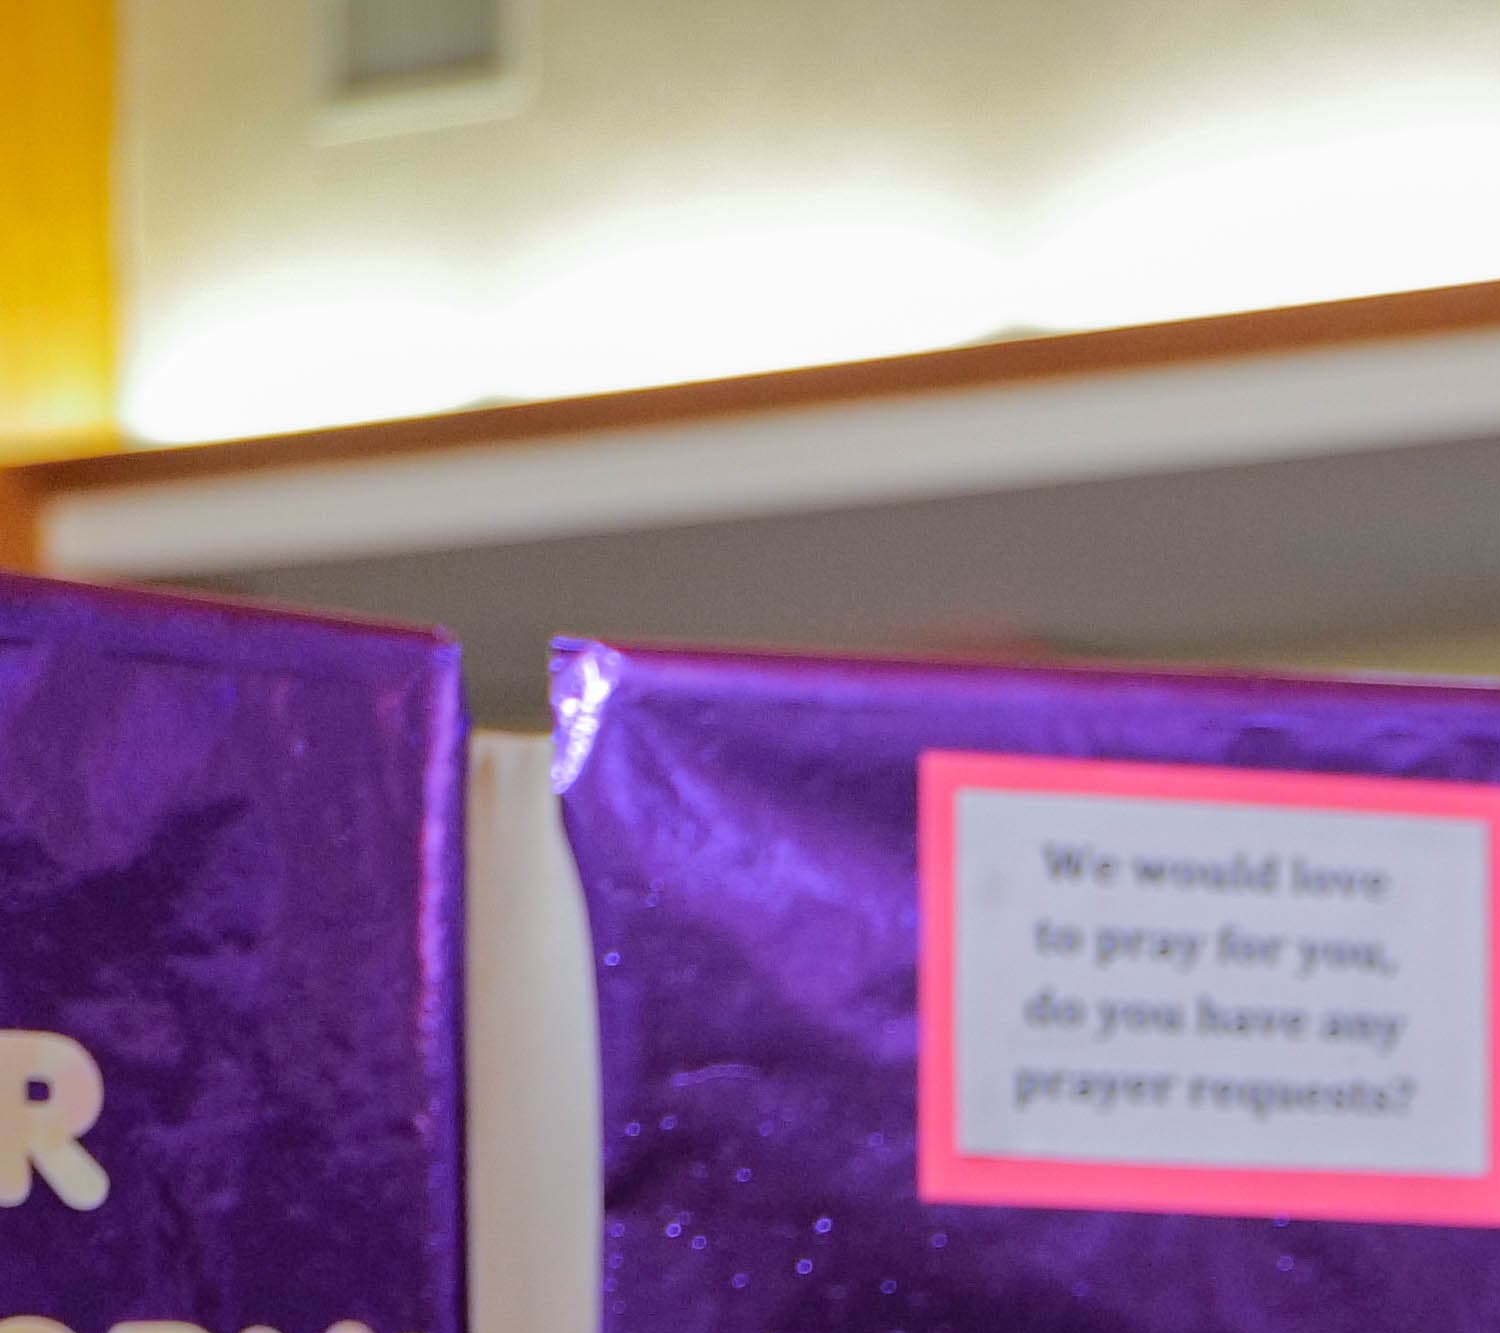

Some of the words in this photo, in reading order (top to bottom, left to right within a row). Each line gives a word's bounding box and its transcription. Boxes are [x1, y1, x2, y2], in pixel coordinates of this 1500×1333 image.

[1041, 841, 1118, 884] We
[1133, 851, 1278, 892] would
[1291, 859, 1390, 898] love
[1034, 918, 1082, 955] to
[1094, 925, 1203, 972] pray
[1215, 927, 1285, 965] for
[1023, 989, 1083, 1027] do
[1096, 1002, 1182, 1045] you
[1196, 999, 1304, 1041] have
[1320, 1014, 1402, 1052] any
[1014, 1067, 1175, 1109] prayer
[1189, 1075, 1416, 1120] requests?
